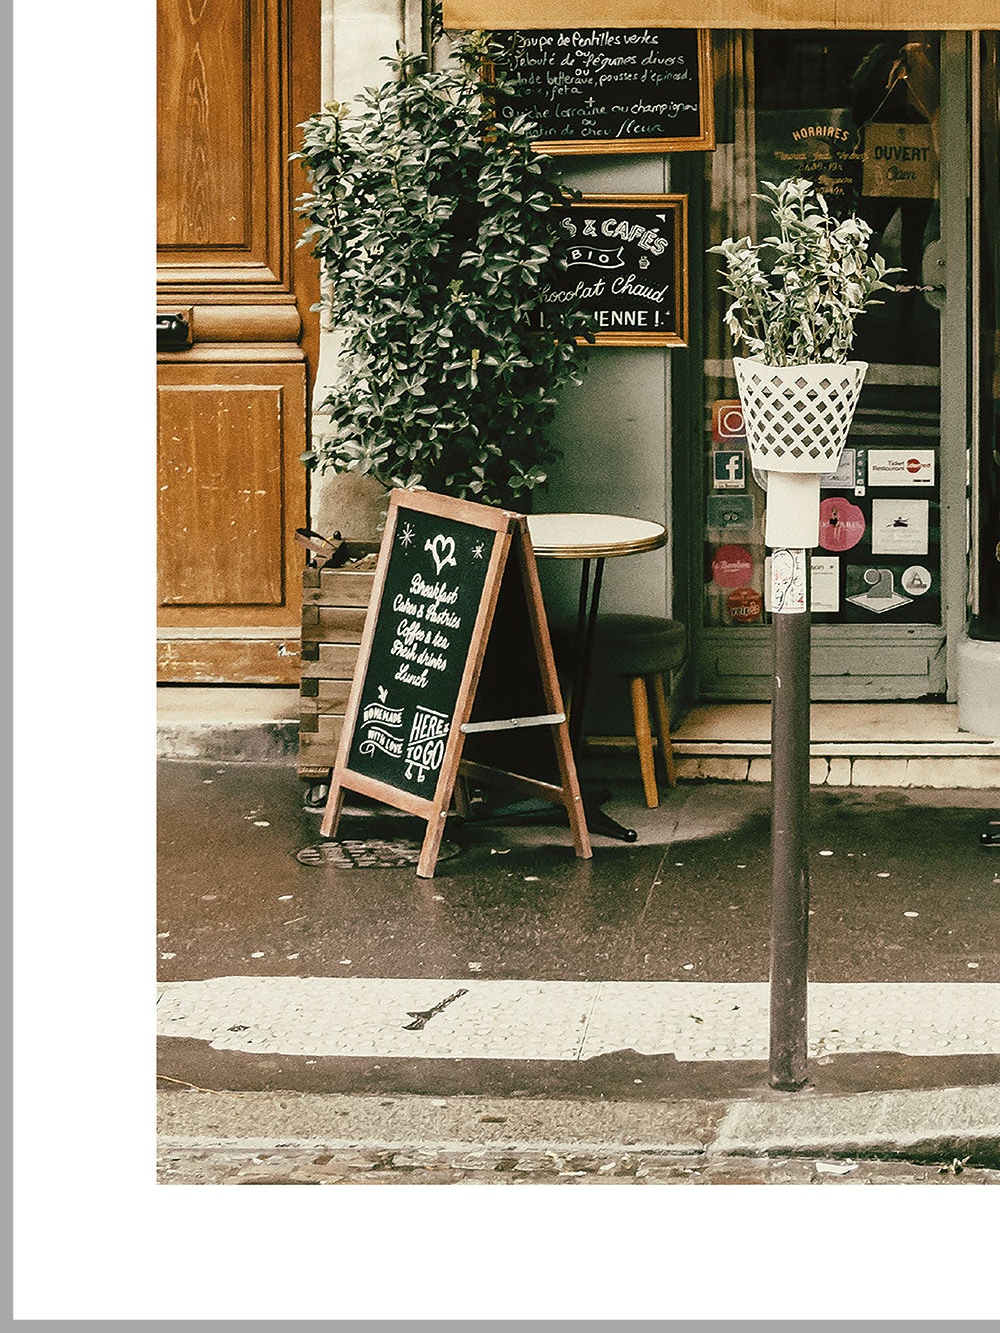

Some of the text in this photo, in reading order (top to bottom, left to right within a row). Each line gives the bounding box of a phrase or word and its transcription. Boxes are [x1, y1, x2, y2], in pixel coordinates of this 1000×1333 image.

[557, 33, 571, 46] de
[623, 29, 659, 45] vertes
[560, 52, 575, 66] de
[575, 49, 591, 57] ou
[575, 68, 590, 76] ou
[792, 126, 849, 142] HORAIRES
[874, 145, 930, 162] OUVERT
[582, 219, 598, 237] &
[601, 218, 669, 256] CAFÉS
[571, 250, 610, 263] BIO
[540, 273, 669, 303] hocolat Chaud
[409, 572, 460, 608] Breakfast
[393, 593, 418, 616] Cakes
[425, 603, 461, 629] Pastries
[397, 618, 425, 646] Coffee
[431, 630, 450, 650] tea
[416, 647, 447, 672] drinks
[394, 663, 429, 689] Lunch
[363, 707, 403, 724] HOMEMADE
[409, 711, 444, 743] HERE
[406, 739, 445, 771] TO GO
